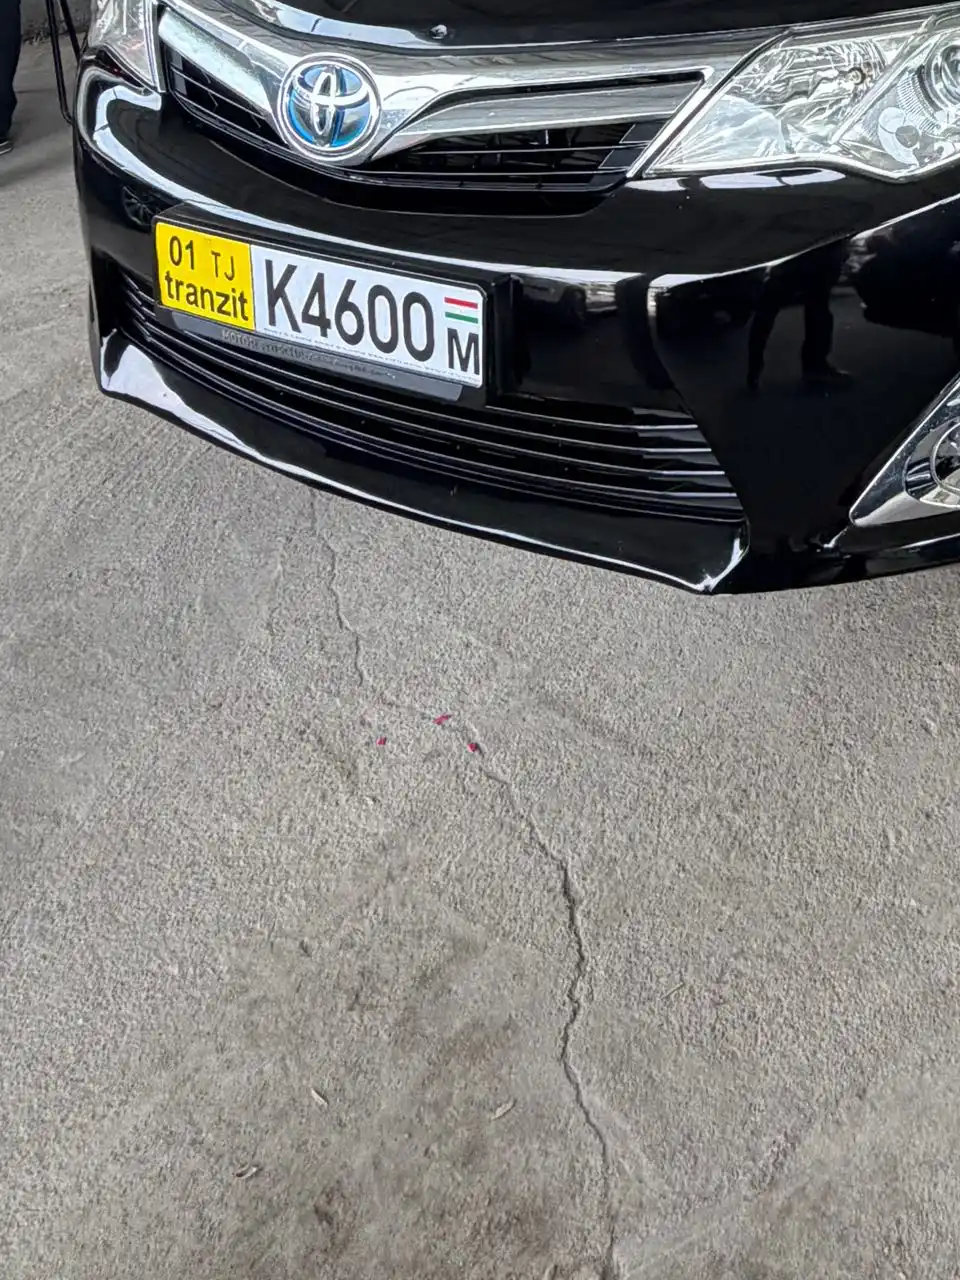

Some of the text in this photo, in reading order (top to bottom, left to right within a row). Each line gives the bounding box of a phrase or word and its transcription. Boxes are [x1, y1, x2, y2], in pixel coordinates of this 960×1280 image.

[169, 235, 235, 281] 01 TJ
[164, 270, 249, 321] tranzit
[264, 259, 435, 363] K4600
[446, 327, 480, 375] M
